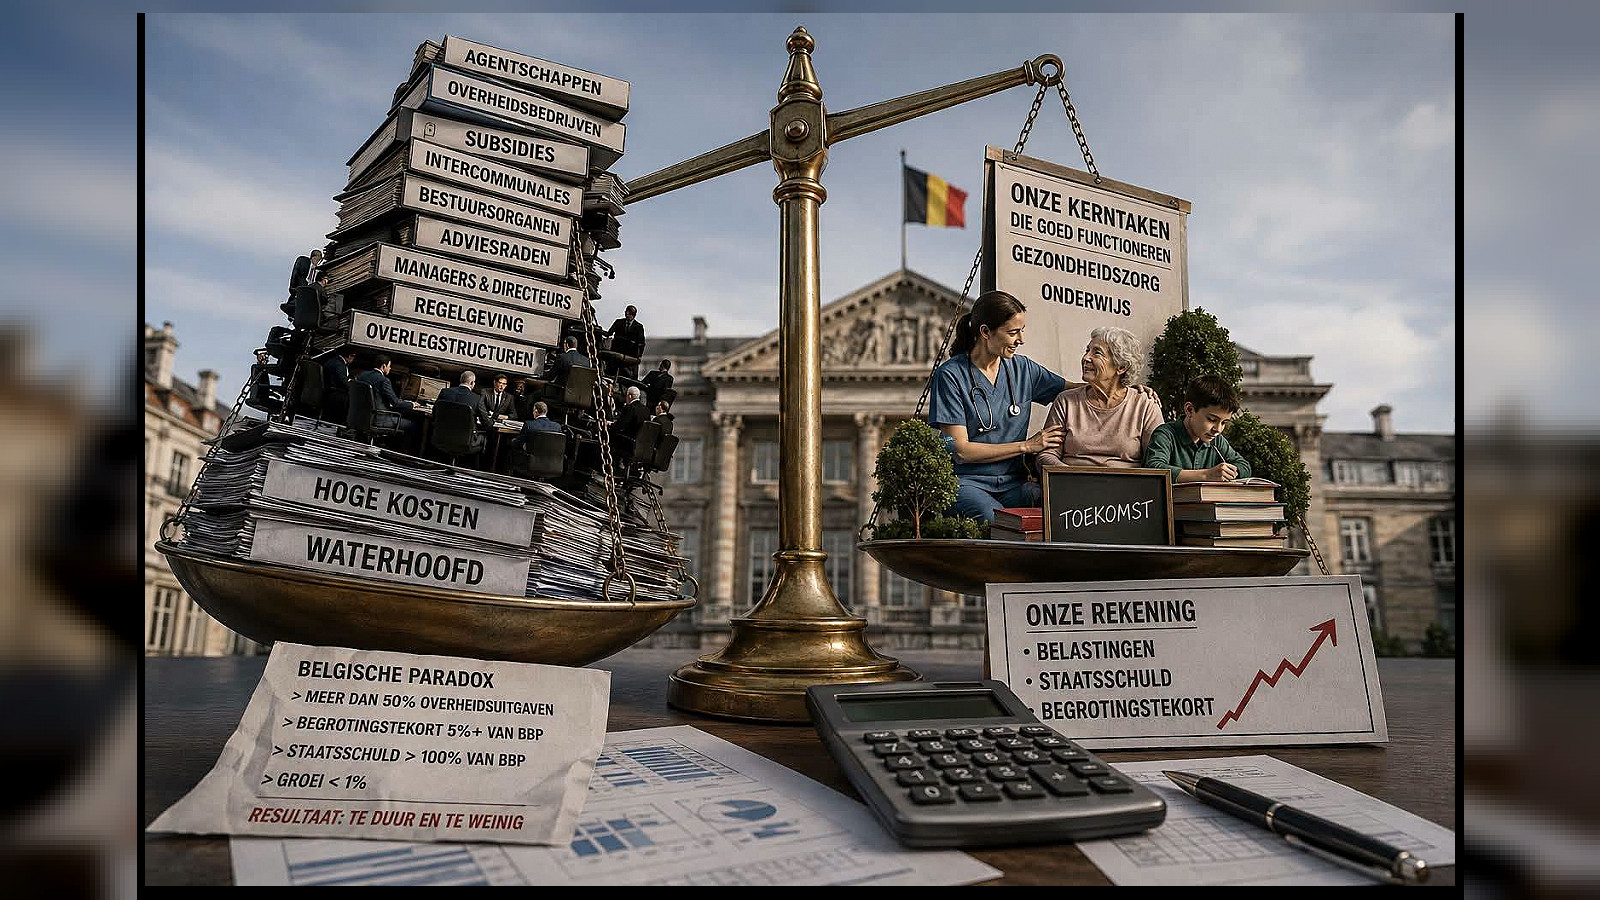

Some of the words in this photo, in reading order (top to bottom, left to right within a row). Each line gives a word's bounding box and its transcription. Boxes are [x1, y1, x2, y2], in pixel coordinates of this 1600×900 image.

[464, 49, 602, 96] AGENTSCHAPPEN
[448, 80, 602, 138] OVERHEIDSBEDRIJVEN
[465, 130, 555, 163] SUBSIDIES
[425, 150, 571, 206] INTERCOMMUNALES
[419, 185, 560, 237] BESTUURSORGANEN
[1010, 182, 1062, 214] ONZE
[1068, 196, 1170, 241] KERNTAKEN
[440, 228, 551, 267] ADVIESRADEN
[1010, 211, 1033, 231] DIE
[1037, 218, 1074, 240] GOED
[1077, 228, 1171, 264] FUNCTIONEREN
[394, 256, 477, 290] MANAGERS
[478, 275, 489, 292] &
[492, 278, 572, 310] DIRECTEURS
[1012, 244, 1160, 293] GEZONDHEIDSZORG
[414, 296, 524, 334] REGELGEVING
[1041, 283, 1131, 317] ONDERWIJS
[366, 322, 534, 368] OVERLEGSTRUCTUREN
[313, 476, 379, 511] HOGE
[387, 491, 479, 531] KOSTEN
[1059, 499, 1155, 530] TOEKOMST
[306, 534, 484, 586] WATERHOOFD
[1026, 602, 1085, 627] ONZE
[1092, 599, 1197, 625] REKENING
[1037, 639, 1155, 661] BELASTINGEN
[297, 660, 403, 684] BELGISCHE
[408, 666, 495, 689] PARADOX
[1039, 669, 1172, 691] STAATSSCHULD
[304, 690, 344, 706] MEER
[348, 692, 379, 707] DAN
[382, 693, 416, 709] 50%
[420, 696, 554, 717] OVERHEIDSUITGAVEN
[1042, 698, 1215, 721] BEGROTINGSTEKORT
[296, 716, 444, 738] BEGROTINGSTEKORT
[447, 723, 483, 739] 5%+
[487, 725, 514, 740] VAN
[517, 726, 544, 741] BBP
[286, 743, 401, 764] STAATSSCHULD
[420, 749, 463, 766] 100%
[466, 751, 495, 766] VAN
[498, 752, 527, 767] BBP
[276, 772, 324, 789] GROEI
[344, 774, 367, 791] 1%
[248, 807, 345, 826] RESULTAAT:
[348, 810, 366, 826] TE
[369, 811, 416, 828] DUUR
[419, 812, 441, 828] EN
[444, 813, 464, 828] TE
[467, 814, 525, 831] WEINIG
